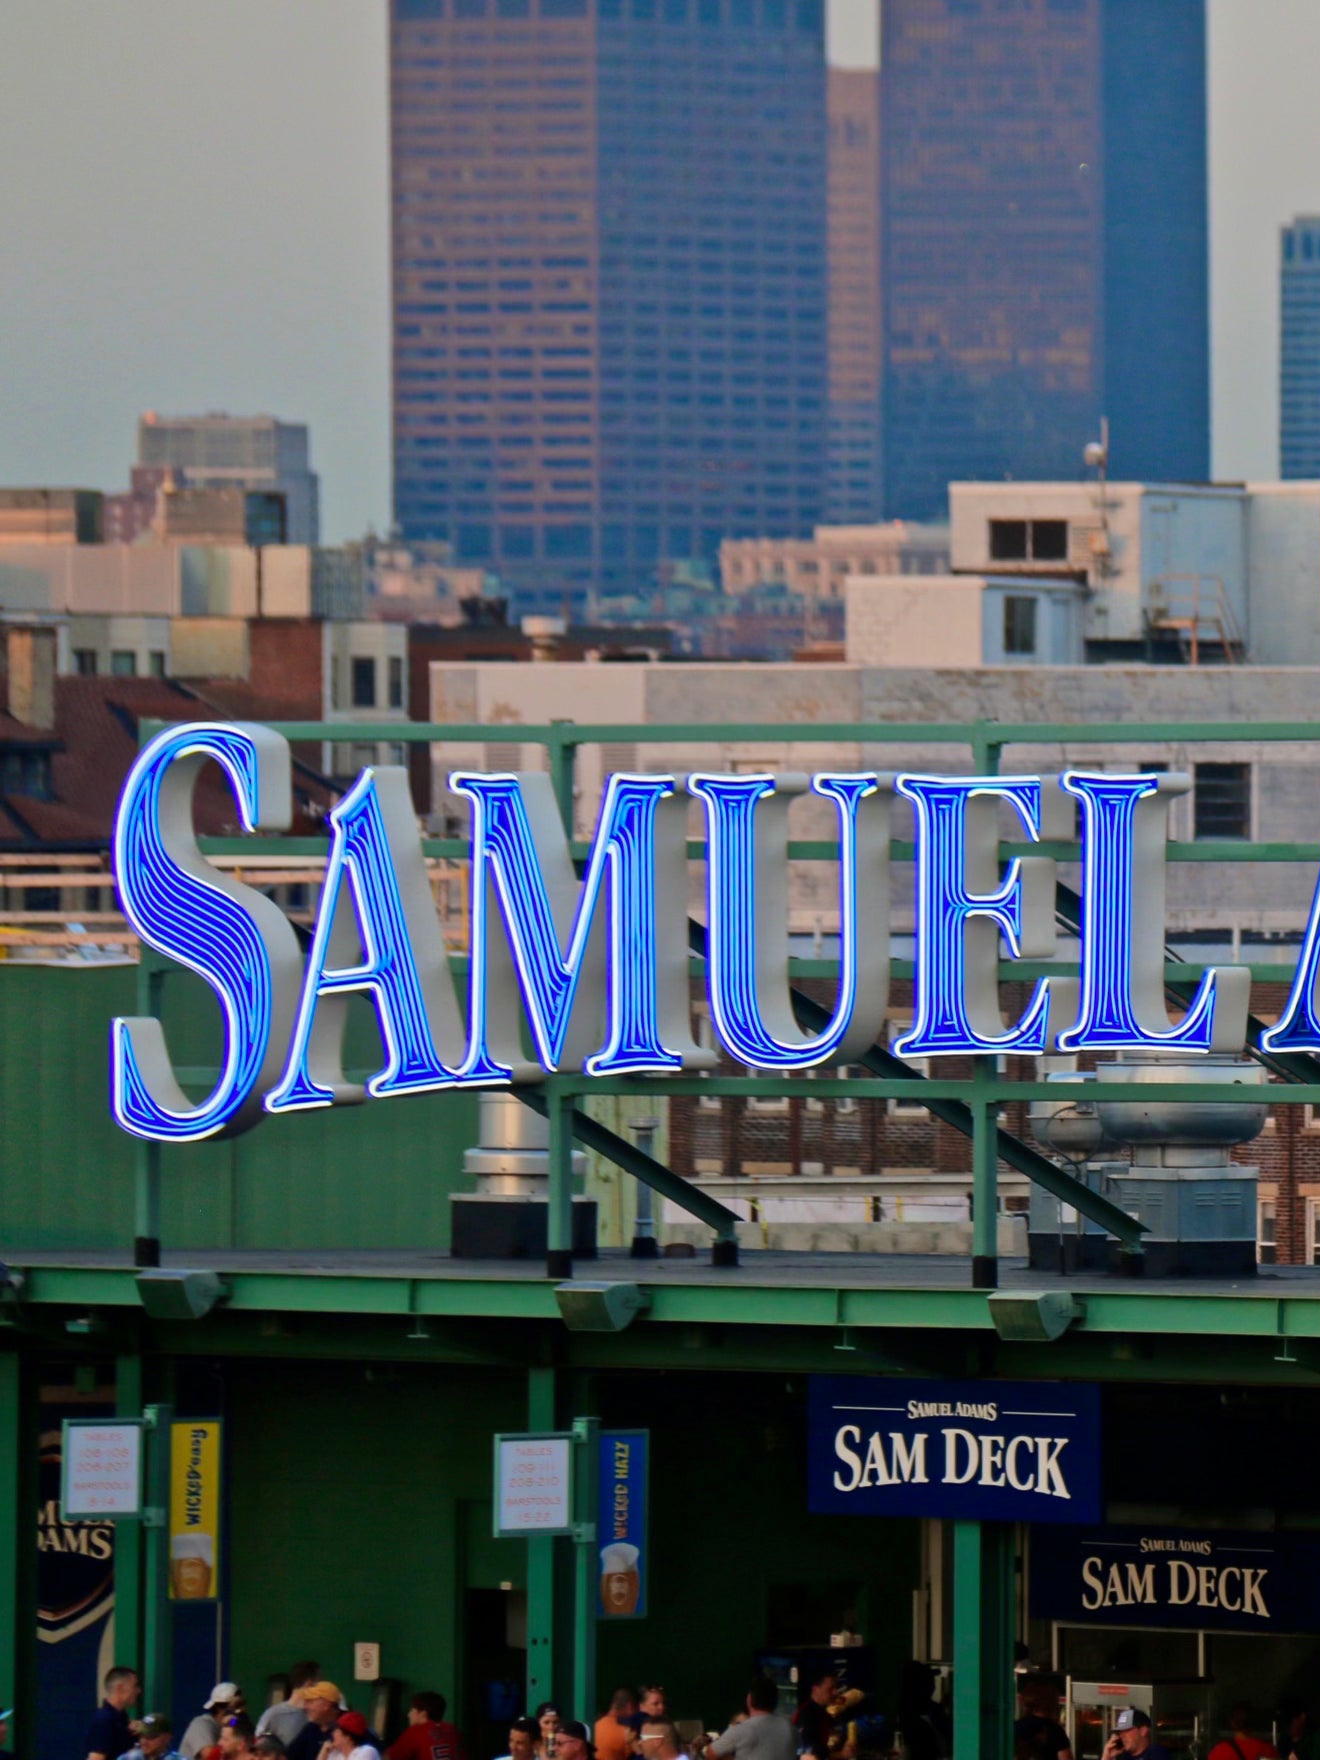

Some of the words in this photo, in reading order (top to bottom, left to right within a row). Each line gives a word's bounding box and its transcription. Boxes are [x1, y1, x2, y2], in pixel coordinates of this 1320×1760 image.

[109, 721, 1219, 1142] SAMUEL
[907, 1400, 955, 1419] SAMUEL
[955, 1402, 998, 1421] ADAMS
[833, 1424, 930, 1492] SAM
[941, 1428, 1072, 1499] DECK
[1139, 1537, 1177, 1552] SAMUEL
[1178, 1539, 1212, 1556] ADAMS
[1081, 1556, 1157, 1611] SAM
[1167, 1560, 1272, 1618] DECK
